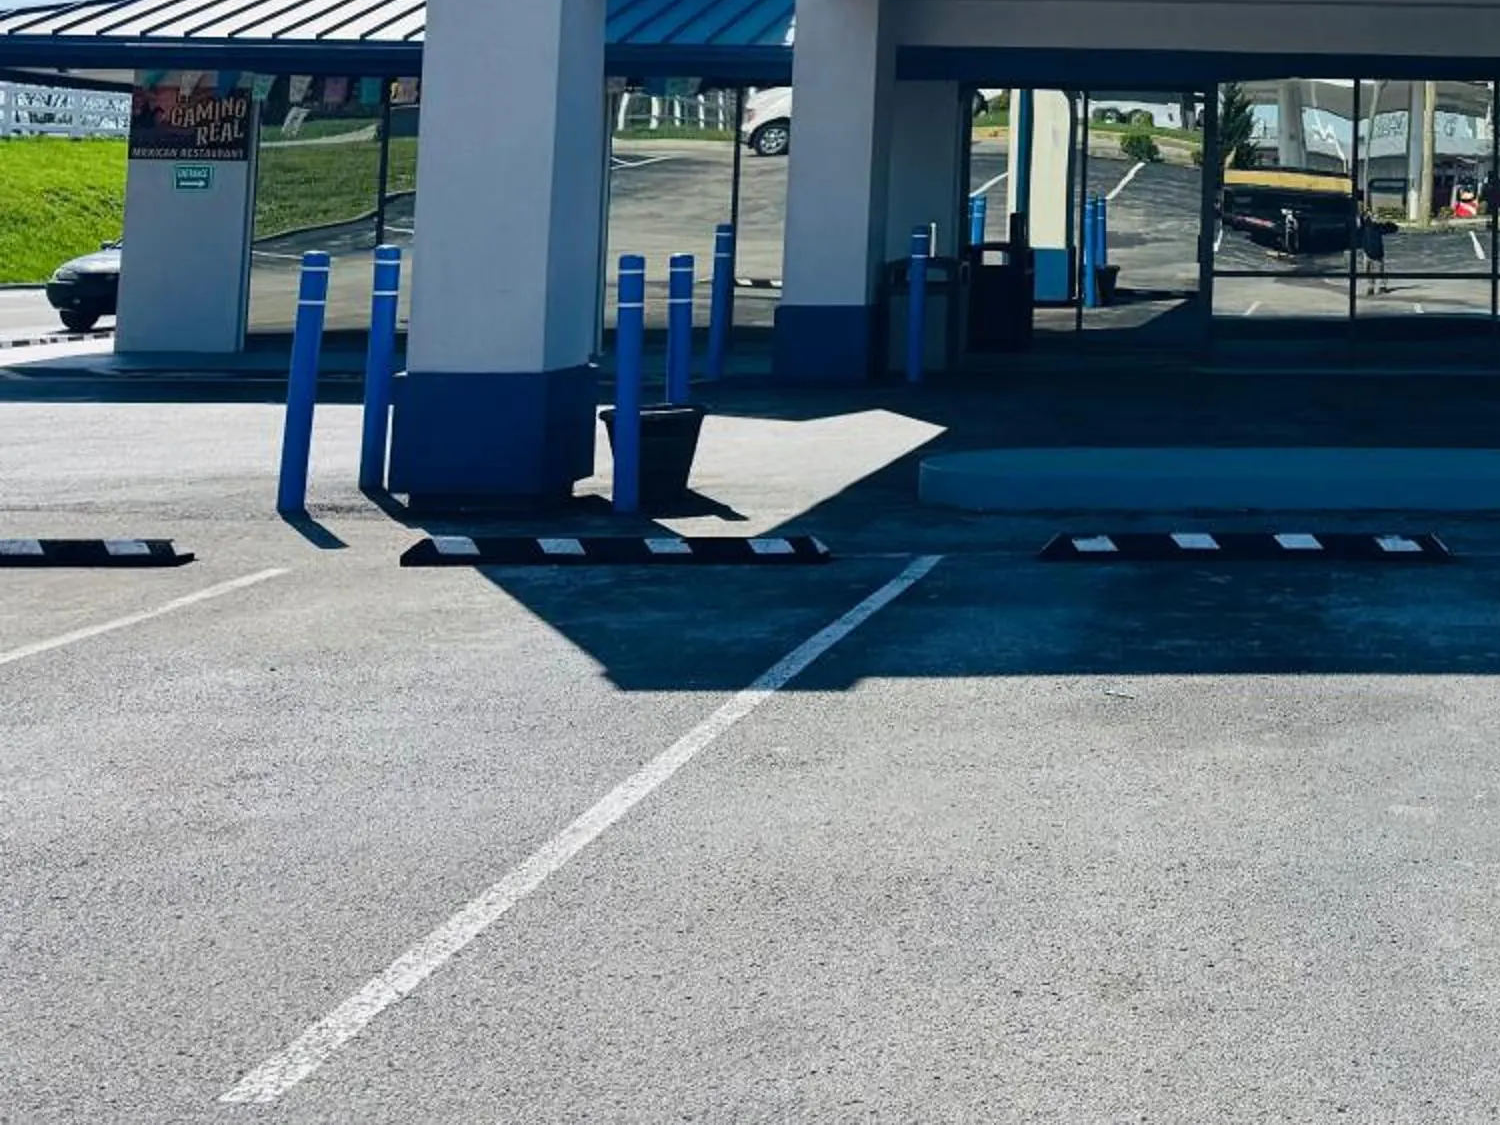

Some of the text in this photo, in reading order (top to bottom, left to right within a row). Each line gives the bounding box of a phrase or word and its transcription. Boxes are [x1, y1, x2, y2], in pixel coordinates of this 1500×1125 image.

[170, 96, 247, 128] CAMINO
[196, 118, 245, 146] REAL
[132, 147, 244, 159] MEXICAN RESTAURANT
